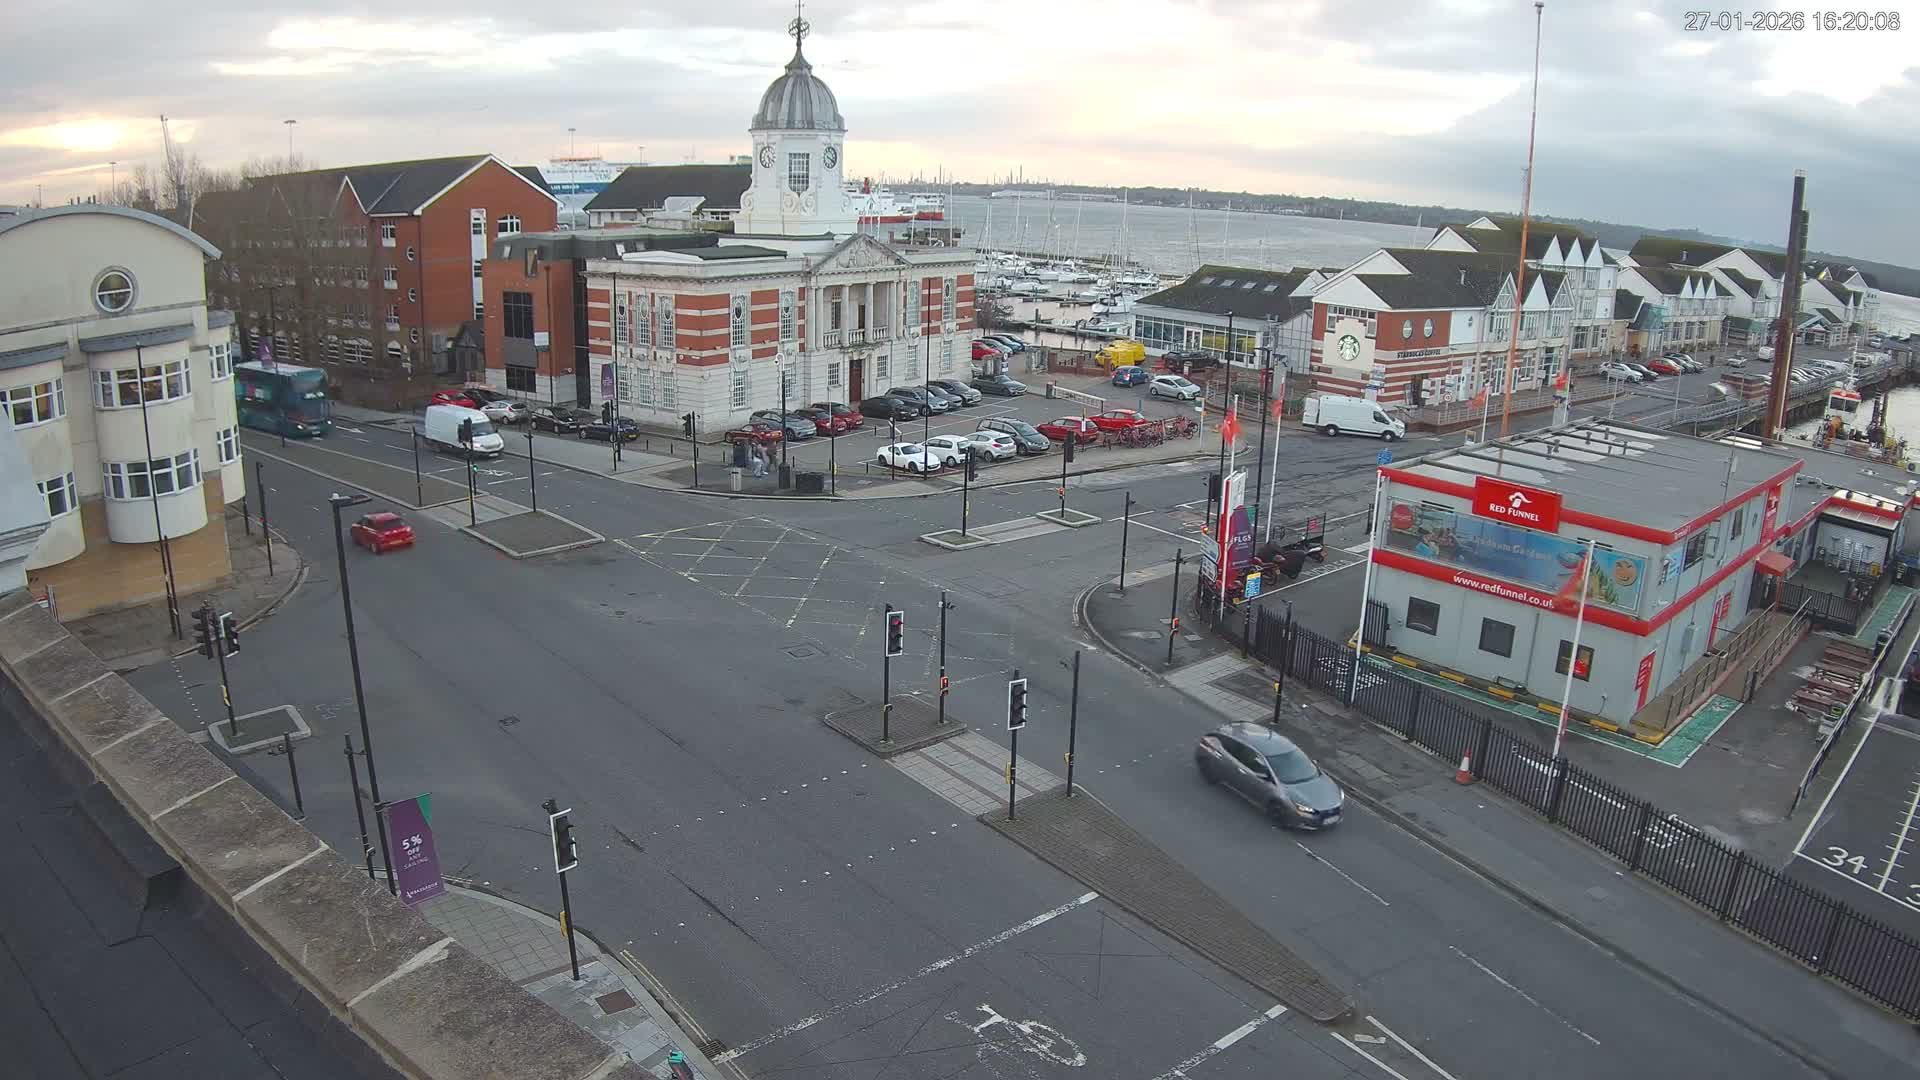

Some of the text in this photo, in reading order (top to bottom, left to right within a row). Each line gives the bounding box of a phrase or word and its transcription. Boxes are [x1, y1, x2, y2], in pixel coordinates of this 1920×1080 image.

[1489, 503, 1540, 522] RED FUNNEL
[407, 846, 420, 856] OFF
[1821, 846, 1868, 874] 34
